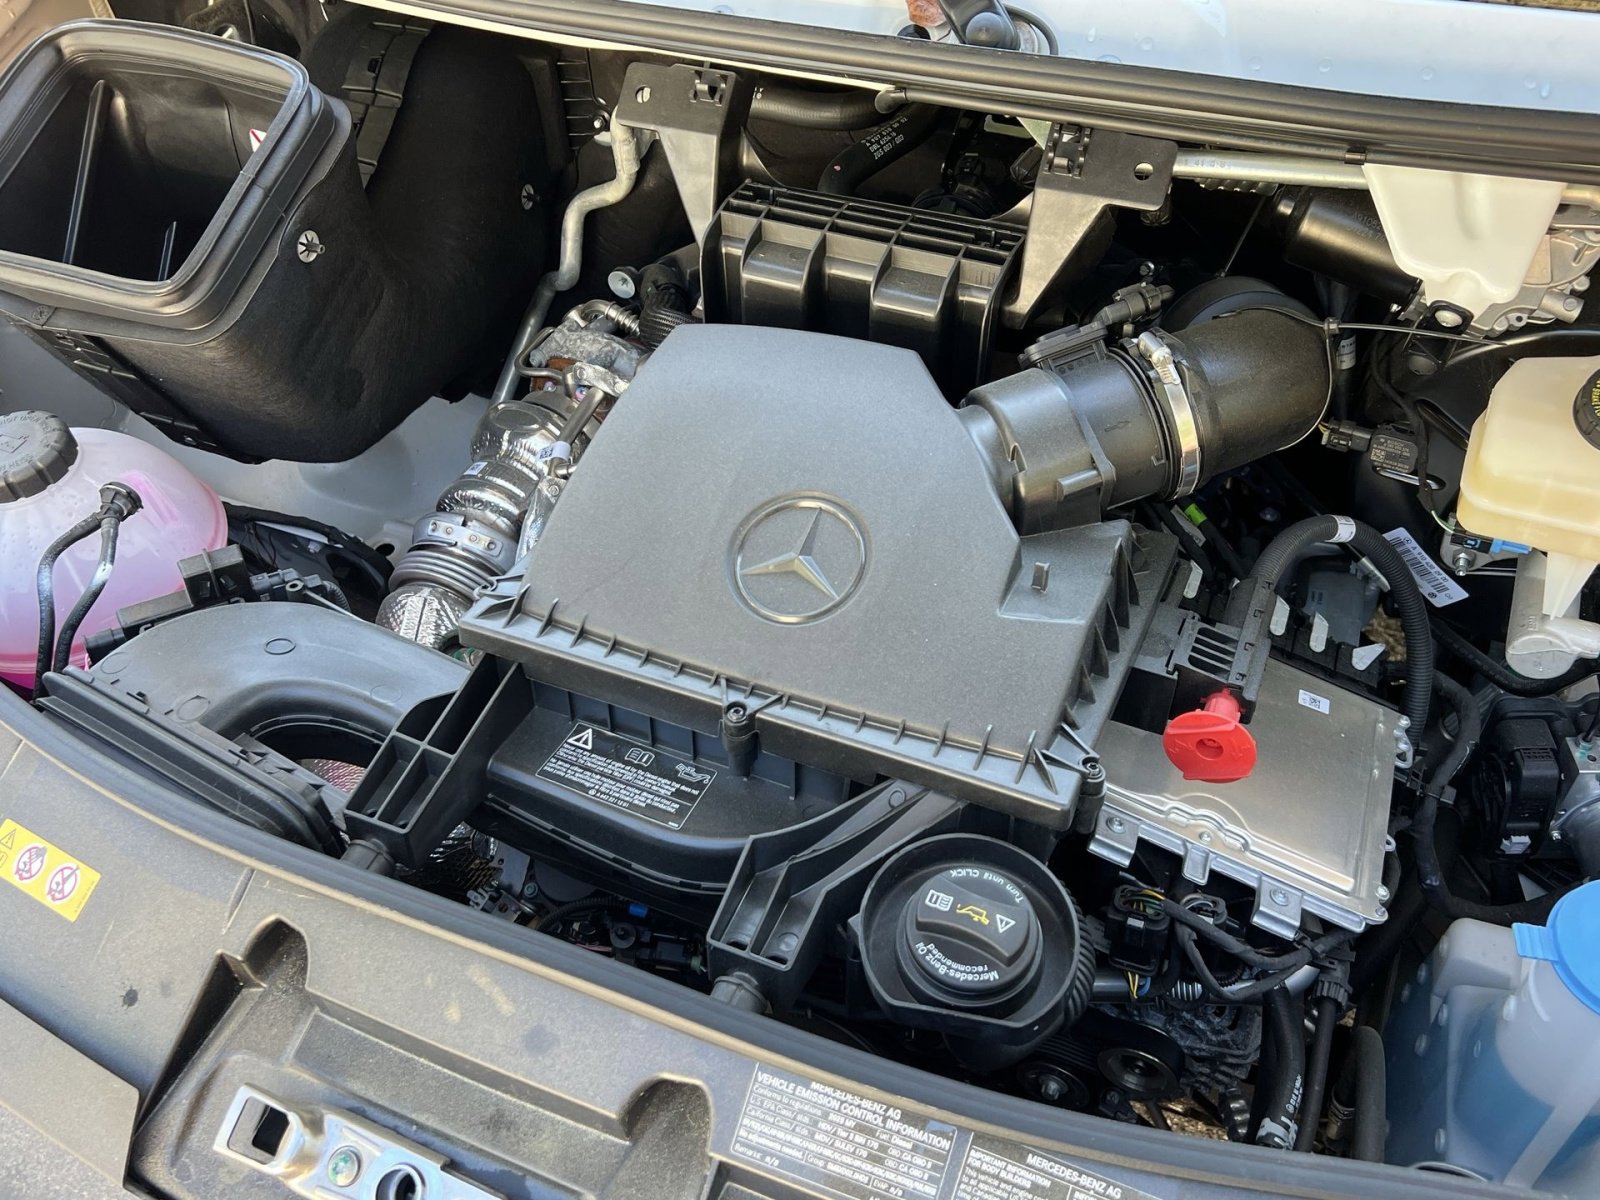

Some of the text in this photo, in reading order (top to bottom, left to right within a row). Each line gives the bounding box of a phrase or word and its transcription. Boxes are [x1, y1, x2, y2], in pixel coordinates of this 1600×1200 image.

[950, 869, 1024, 904] Turn until CLICK
[915, 941, 1000, 982] Mercedes-Benz Oil
[926, 943, 989, 973] recommended
[756, 1072, 950, 1149] VEHICLE EMISSION CONTROL INFORMATION
[886, 1108, 901, 1119] AG
[891, 1135, 912, 1148] Diesel
[967, 1157, 1031, 1188] FOR BODY BUILDERS
[970, 1149, 1051, 1187] IMPORTANT INFORMATION
[1026, 1153, 1122, 1197] MERCEDES-BENZ AG
